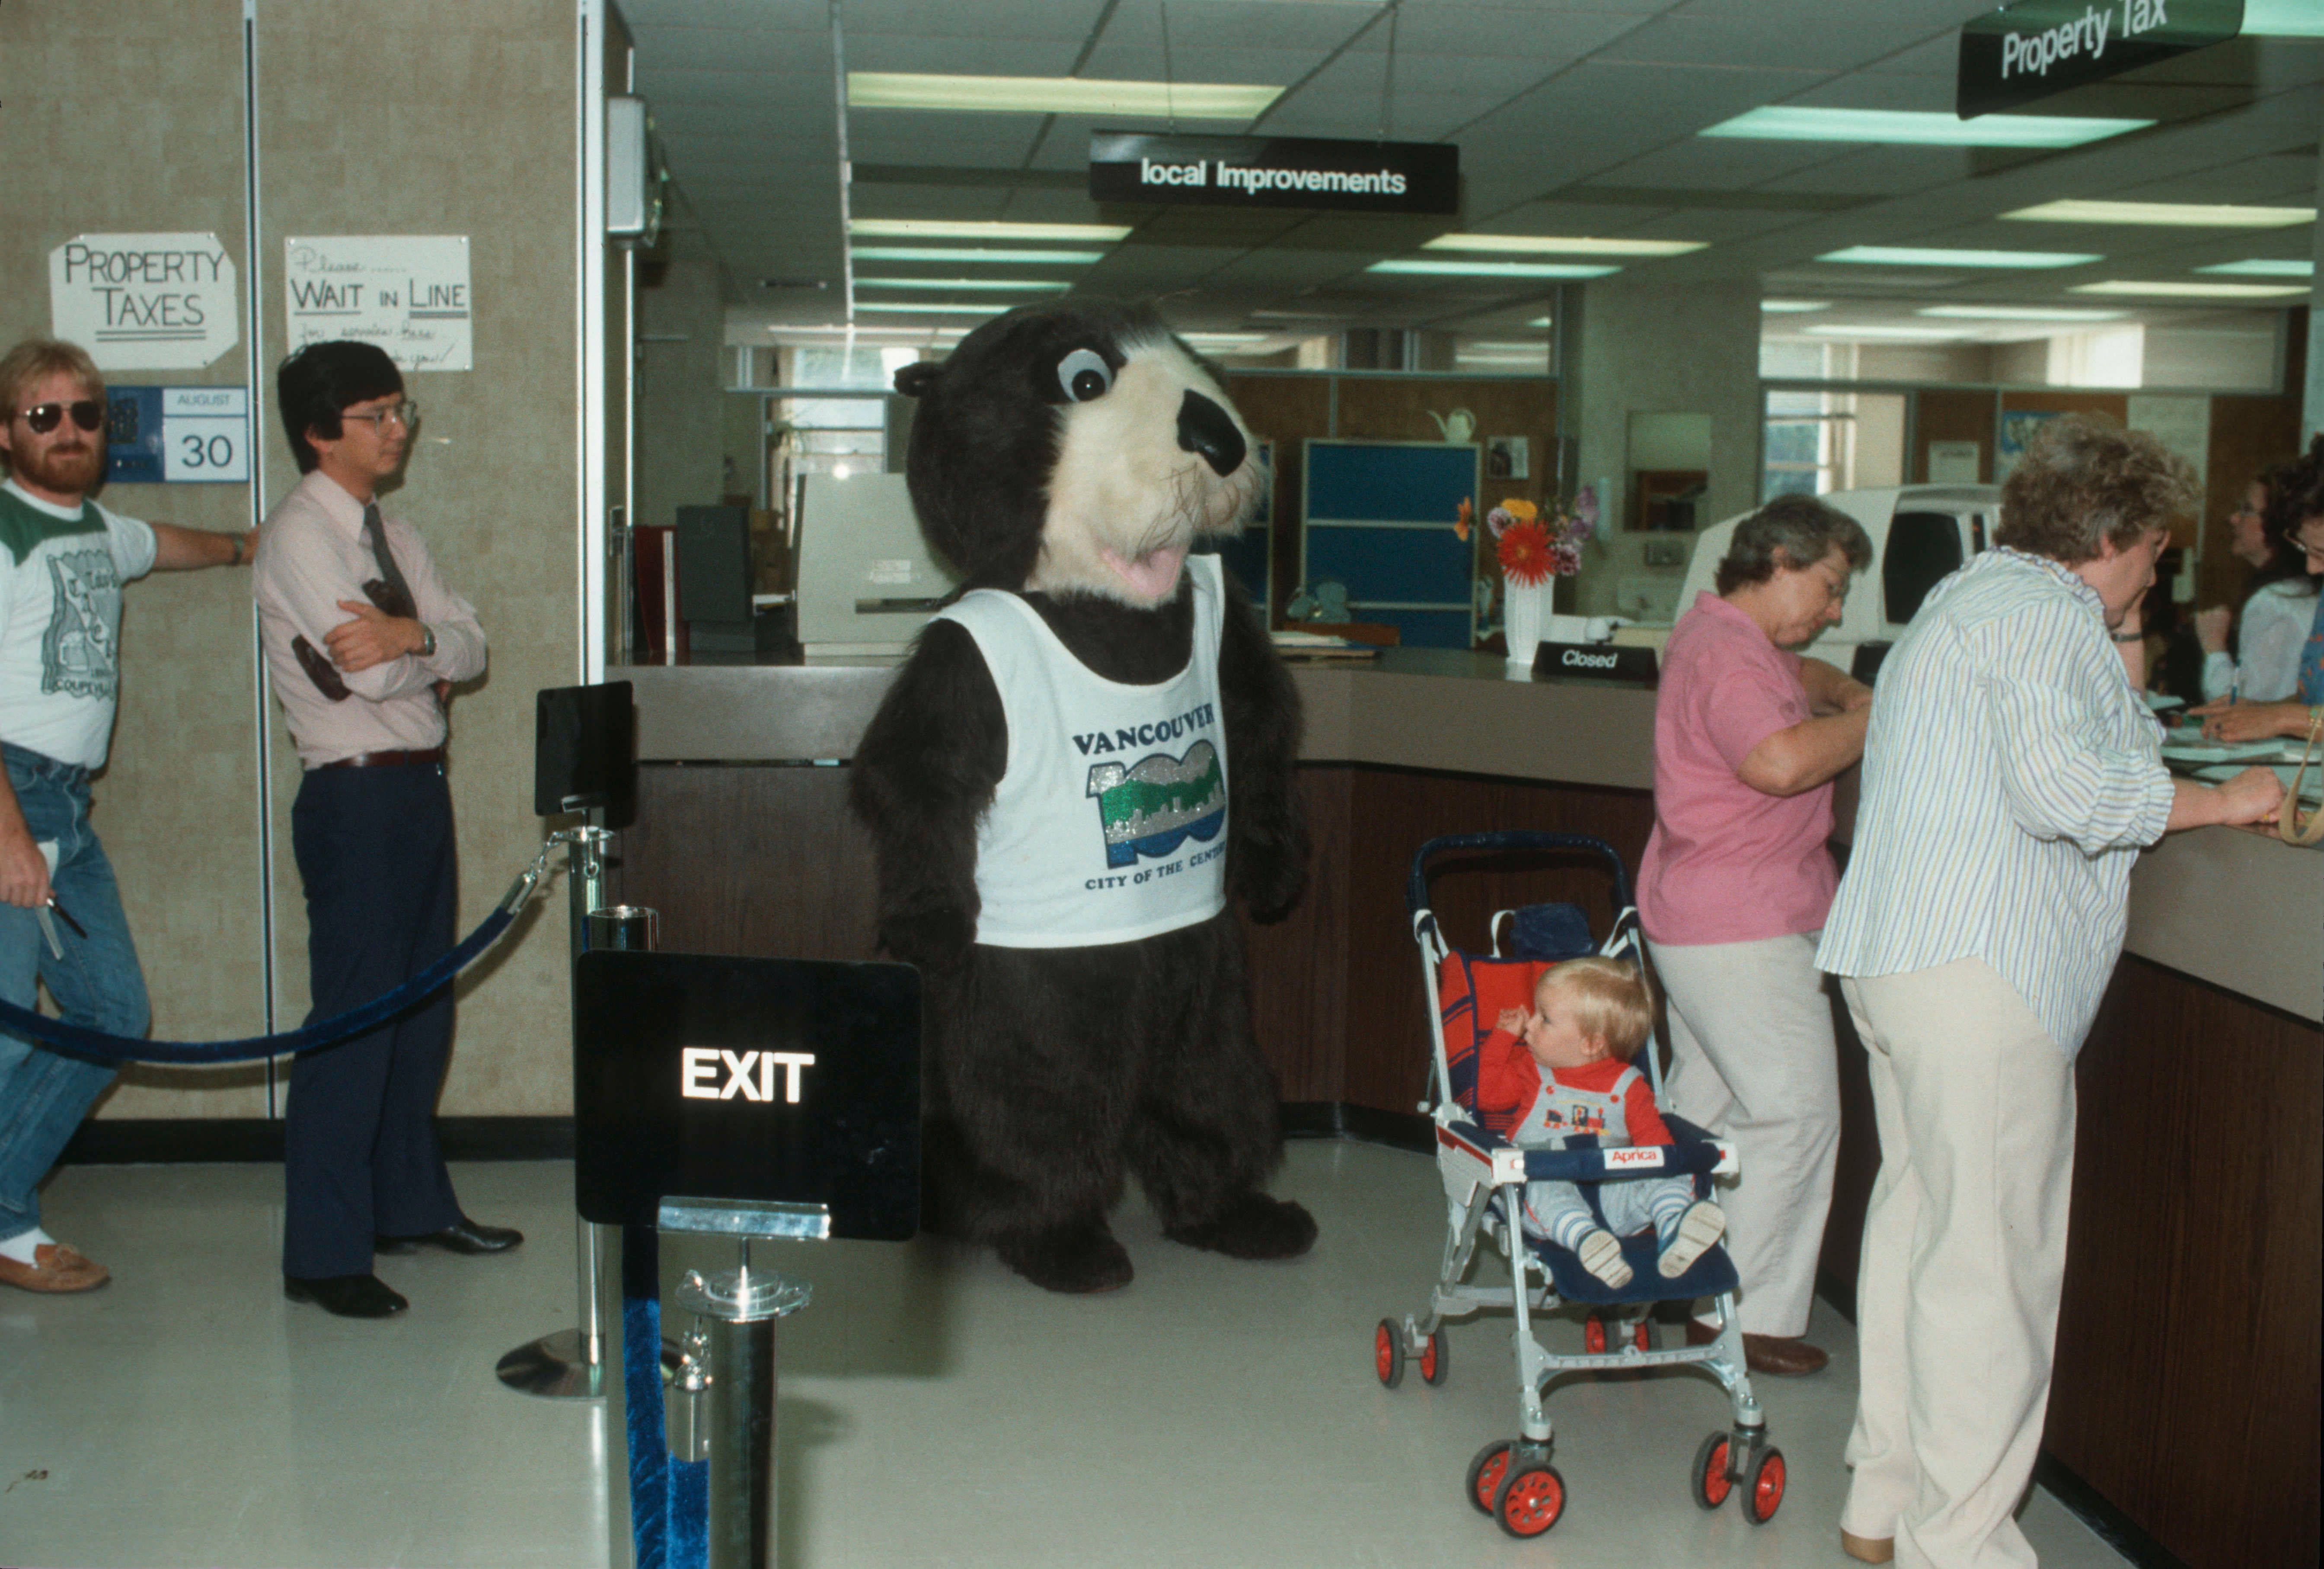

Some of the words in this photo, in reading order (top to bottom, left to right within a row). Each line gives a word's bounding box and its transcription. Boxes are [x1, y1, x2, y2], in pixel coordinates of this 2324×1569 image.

[2002, 5, 2112, 79] Property
[2120, 0, 2168, 38] Tax
[1141, 157, 1206, 185] local
[1216, 160, 1407, 195] Improvements
[65, 243, 226, 284] PROPERTY
[91, 287, 204, 326] TAXES
[290, 278, 364, 308] WAIT
[409, 278, 466, 307] LINE
[178, 394, 231, 405] AUGUST
[182, 435, 233, 468] 30
[1562, 649, 1618, 668] Closed
[1073, 703, 1215, 755] VANCOUVER
[1085, 875, 1127, 890] CITY
[1133, 869, 1152, 884] OF
[1157, 860, 1183, 878] THE
[682, 1047, 815, 1103] EXIT
[1612, 1148, 1657, 1163] Aprica
